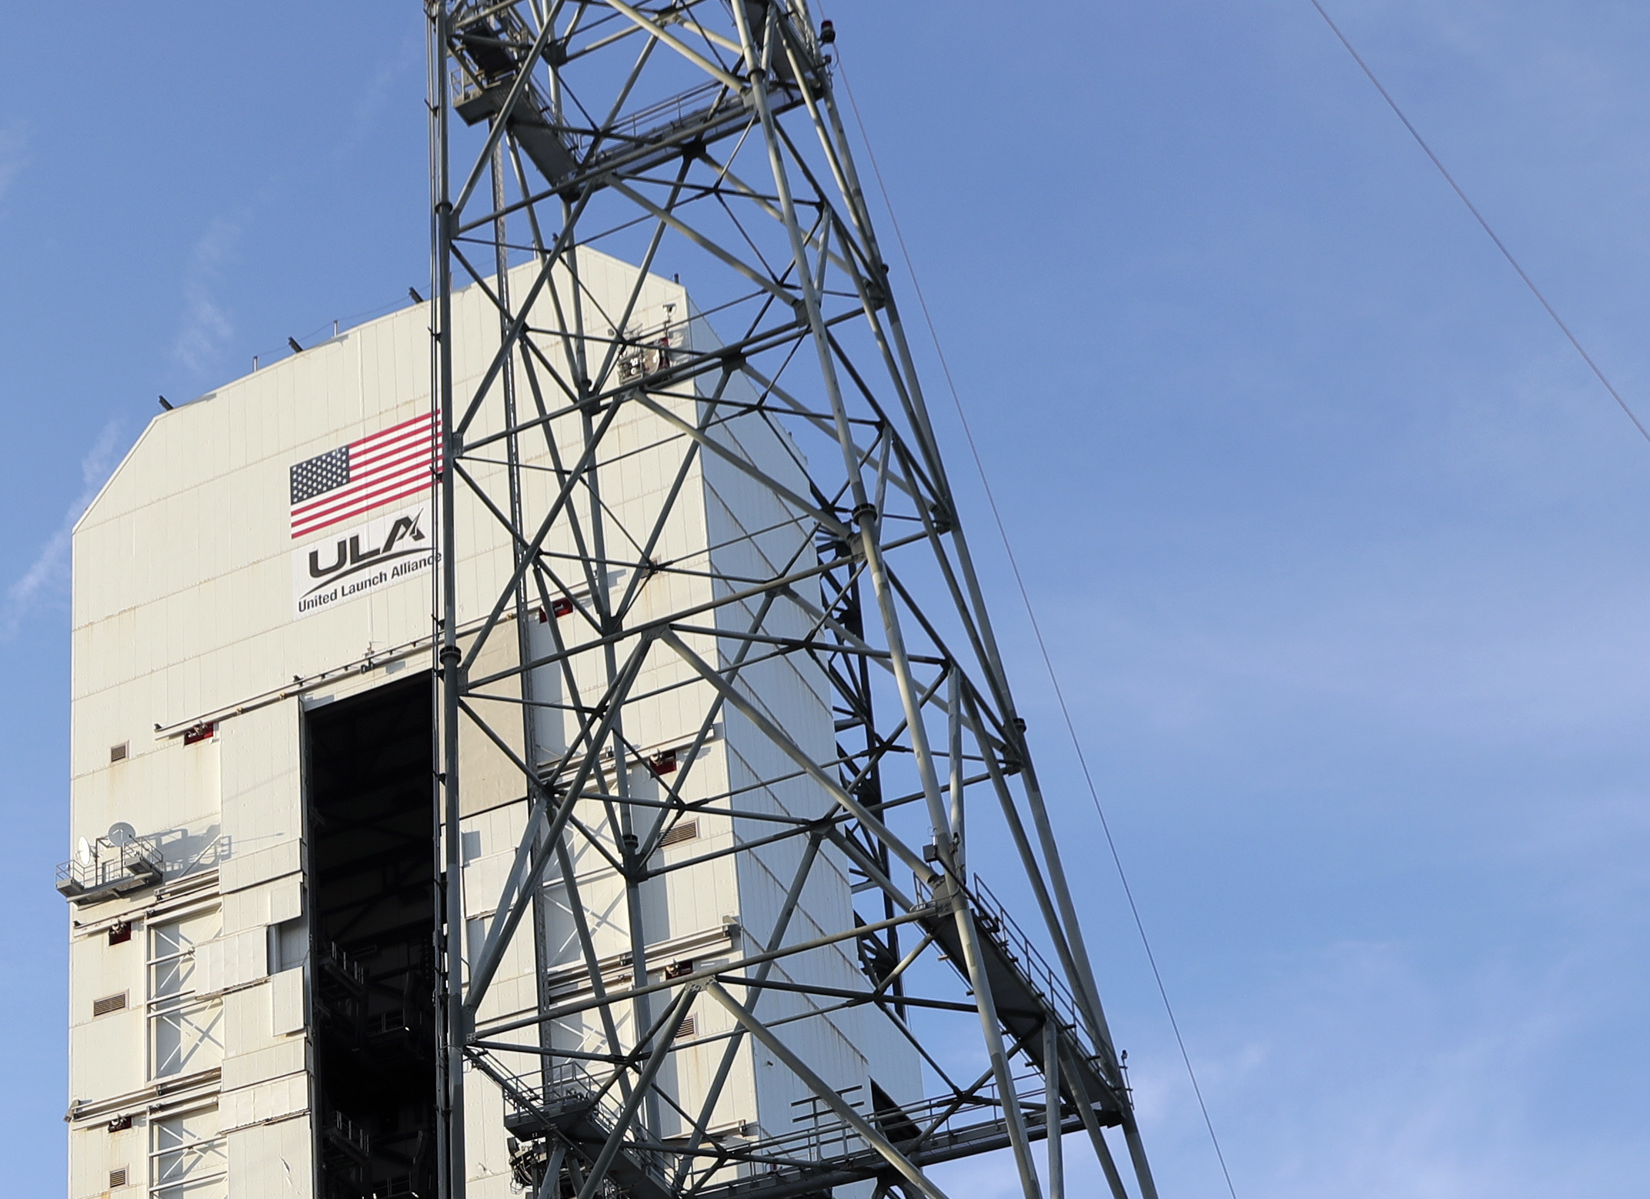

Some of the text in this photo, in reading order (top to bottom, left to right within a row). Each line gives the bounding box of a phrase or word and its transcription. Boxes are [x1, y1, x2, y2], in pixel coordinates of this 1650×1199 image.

[309, 507, 425, 578] ULA
[298, 552, 442, 613] United Launch Alliance
